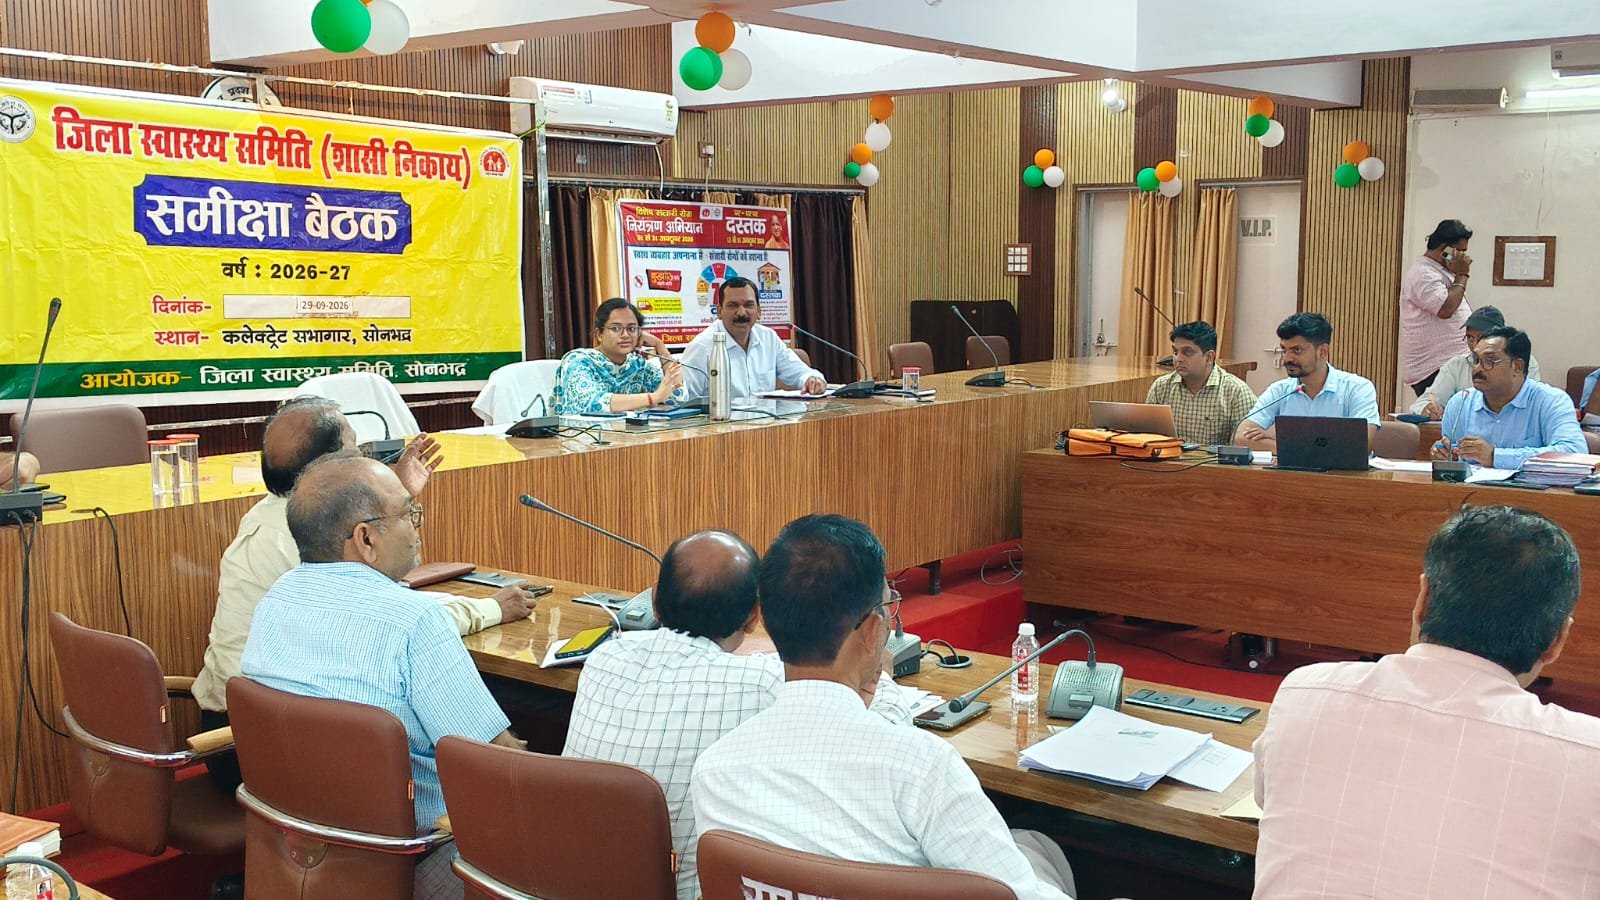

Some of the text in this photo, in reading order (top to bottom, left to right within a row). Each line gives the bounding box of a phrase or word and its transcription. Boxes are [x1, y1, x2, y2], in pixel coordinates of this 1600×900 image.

[52, 106, 133, 155] जिला
[138, 123, 230, 163] स्वास्थ्य
[234, 126, 313, 170] समिति
[320, 133, 389, 180] (शासी
[392, 140, 472, 190] निकाय)
[145, 186, 399, 243] समीक्षा बैठक
[626, 215, 704, 234] नियंत्रण अभियान
[725, 216, 767, 235] दस्तक
[1240, 219, 1272, 237] V.I.P.
[221, 257, 249, 278] वर्ष
[270, 263, 351, 280] 2026-27
[152, 294, 212, 314] दिनांक-
[302, 300, 349, 310] 29-09-2026
[154, 324, 412, 349] स्थान- कलेक्ट्रेट सभागार, सोनभद्र
[200, 365, 255, 385] जिला
[404, 360, 467, 378] सोनभद्र
